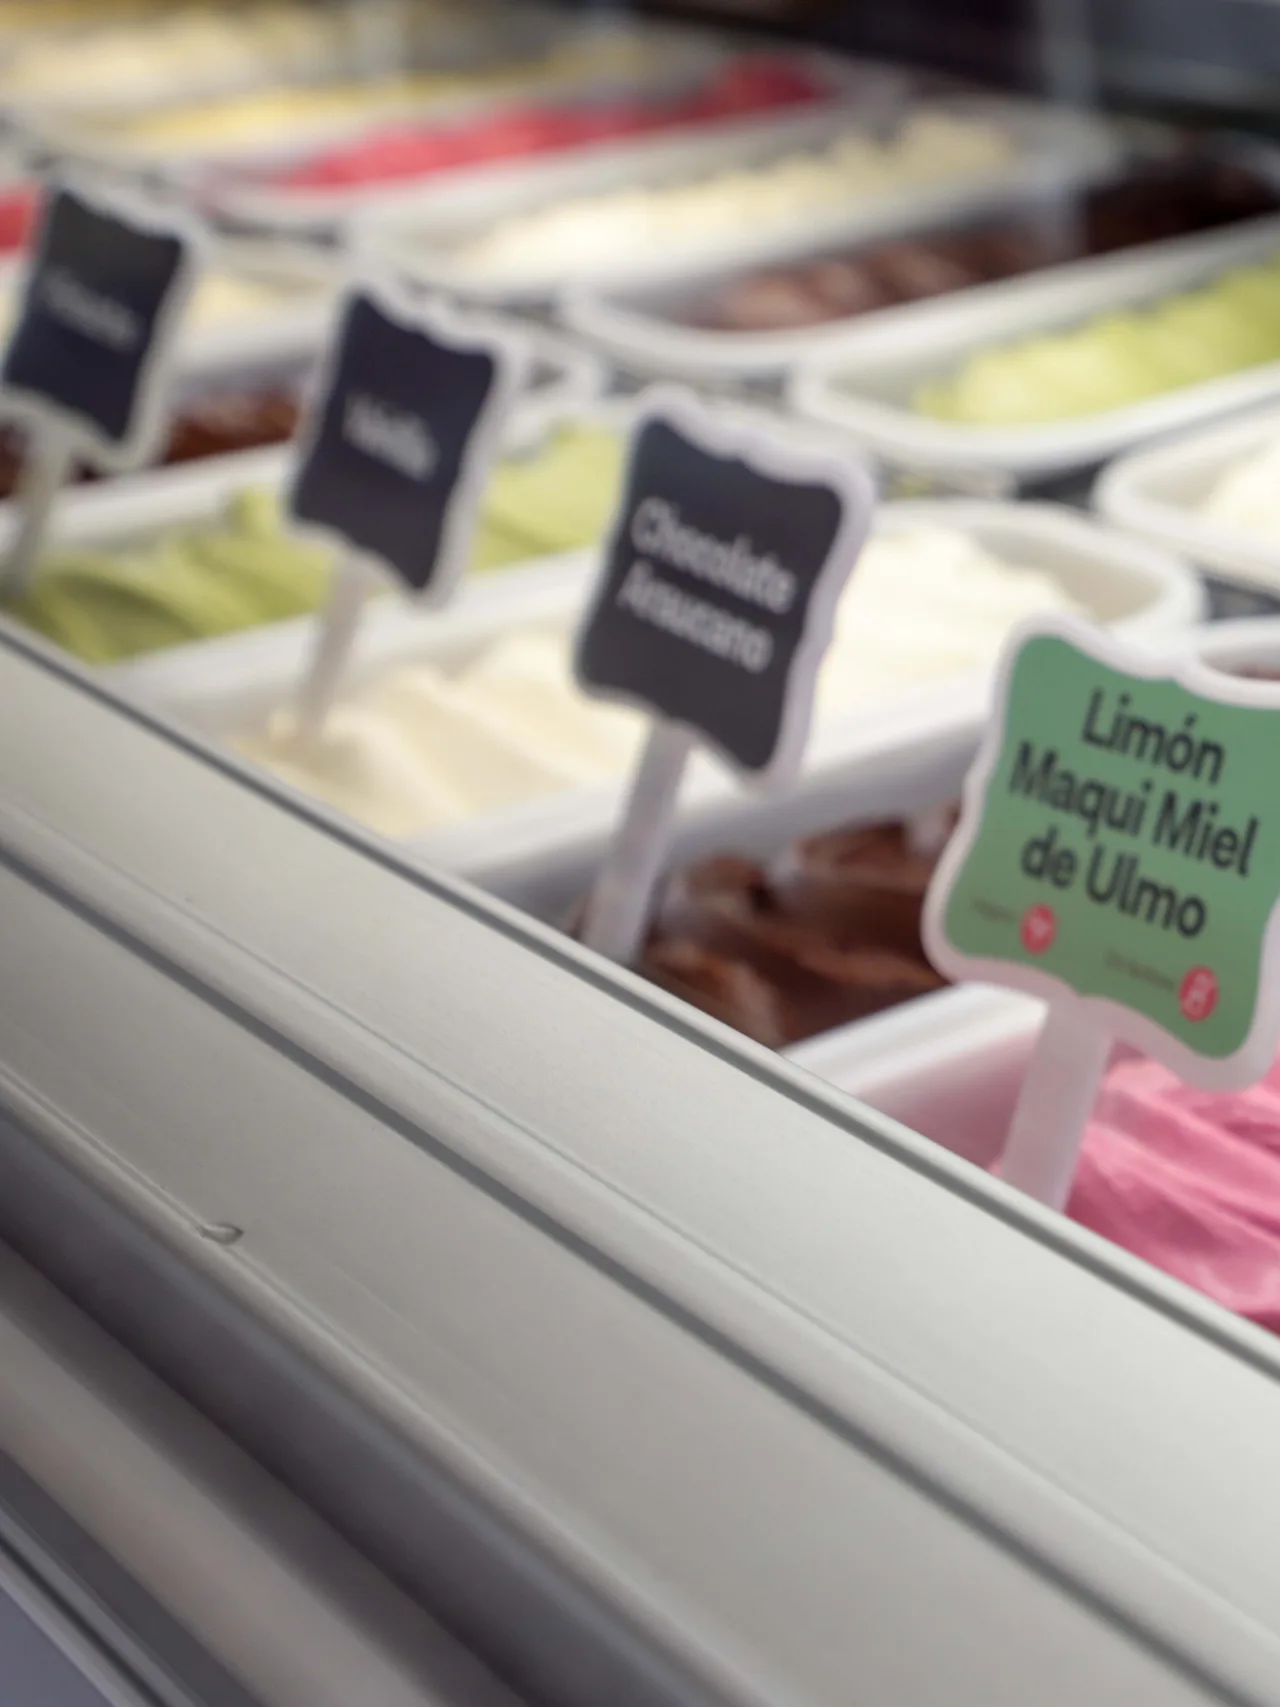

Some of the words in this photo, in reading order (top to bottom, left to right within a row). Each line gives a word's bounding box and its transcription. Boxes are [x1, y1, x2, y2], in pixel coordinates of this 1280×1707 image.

[631, 496, 797, 615] Chocolate
[1080, 687, 1226, 785] Limón
[1008, 740, 1153, 840] Maqui
[1151, 789, 1260, 878] Miel
[1020, 824, 1078, 891] de
[1084, 845, 1207, 939] Ulmo
